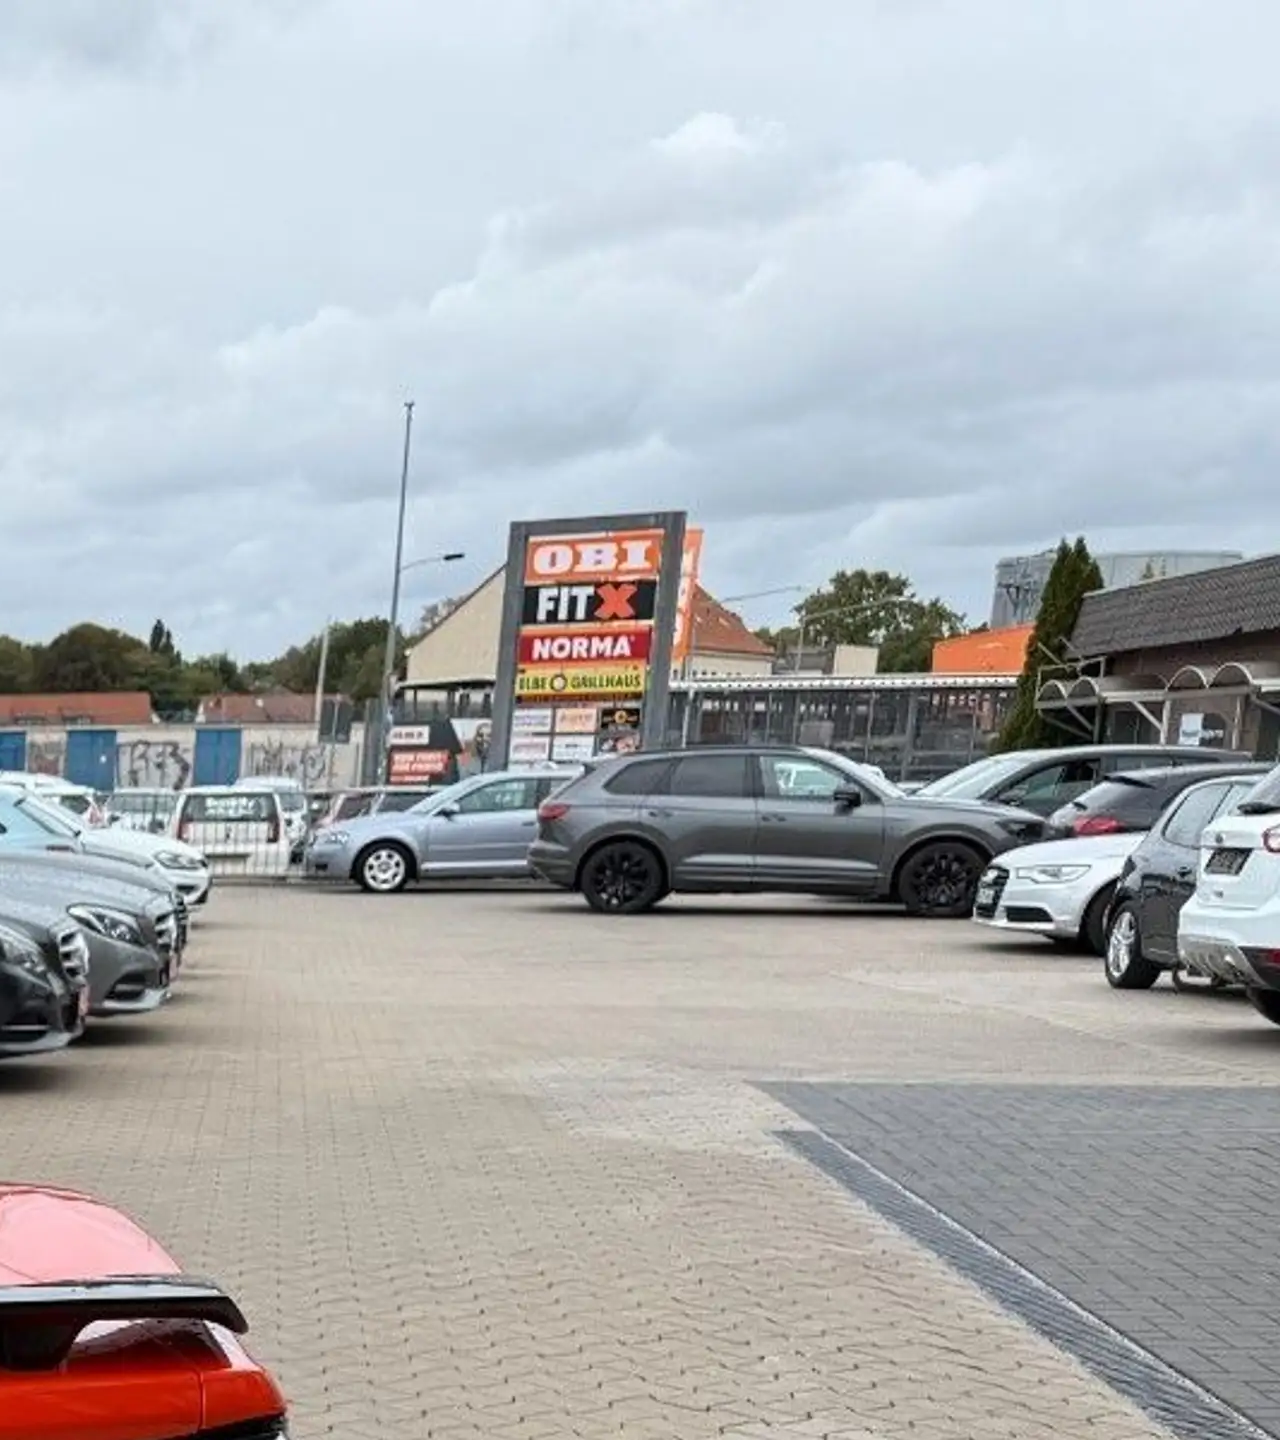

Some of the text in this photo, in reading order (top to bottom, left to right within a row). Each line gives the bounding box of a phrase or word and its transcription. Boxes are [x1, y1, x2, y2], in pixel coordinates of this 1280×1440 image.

[533, 540, 653, 575] OBI
[536, 583, 638, 621] FITX
[531, 635, 632, 660] NORMA
